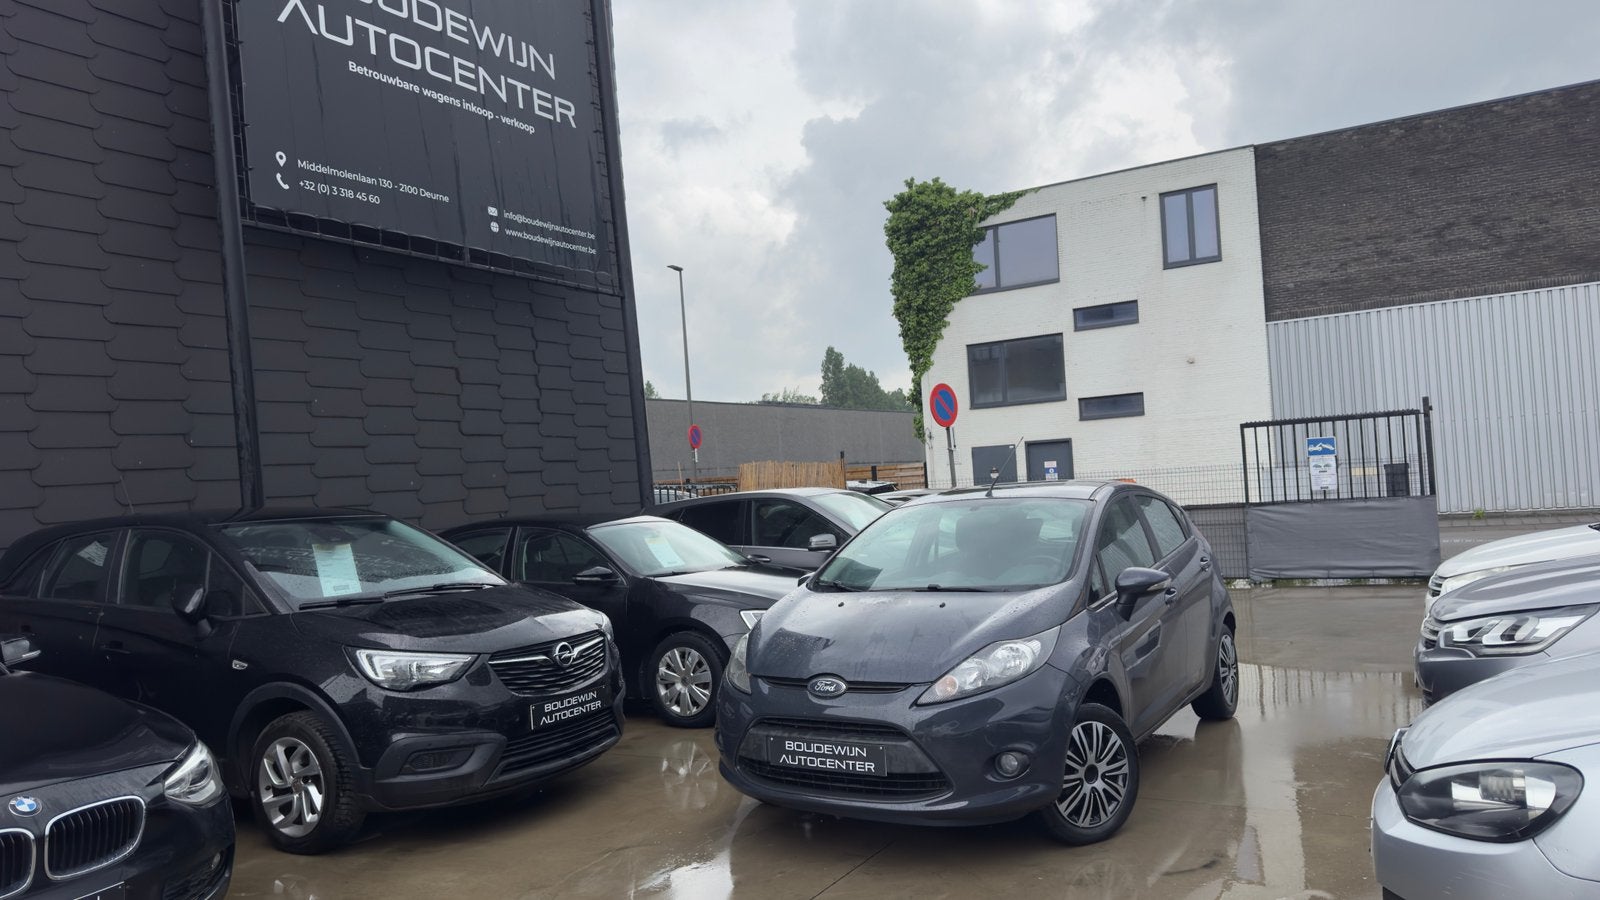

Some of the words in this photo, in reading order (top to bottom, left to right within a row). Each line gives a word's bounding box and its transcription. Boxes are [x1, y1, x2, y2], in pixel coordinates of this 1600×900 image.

[277, 0, 577, 128] AUTOCENTER
[348, 60, 420, 94] Betrouwbare
[421, 86, 461, 108] wagens
[462, 98, 494, 121] inkoop
[500, 114, 535, 135] verkoop
[297, 159, 377, 186] Middelmolenlaan
[378, 177, 393, 189] 130
[399, 183, 418, 195] 2100
[419, 188, 450, 203] Deurne
[299, 180, 316, 192] +32
[317, 183, 330, 196] (0)
[331, 186, 338, 195] 3
[339, 187, 355, 199] 318
[356, 191, 367, 202] 45
[368, 194, 381, 205] 60
[503, 209, 596, 240] info@boudewijnautocenter.be
[504, 228, 597, 255] www.boudewijnautocenter.be
[814, 680, 836, 692] Ford
[540, 700, 602, 726] AUTOCENTER
[544, 690, 597, 713] BOUDEWIJN
[785, 740, 867, 758] BOUDEWIJN
[779, 754, 875, 773] AUTOCENTER
